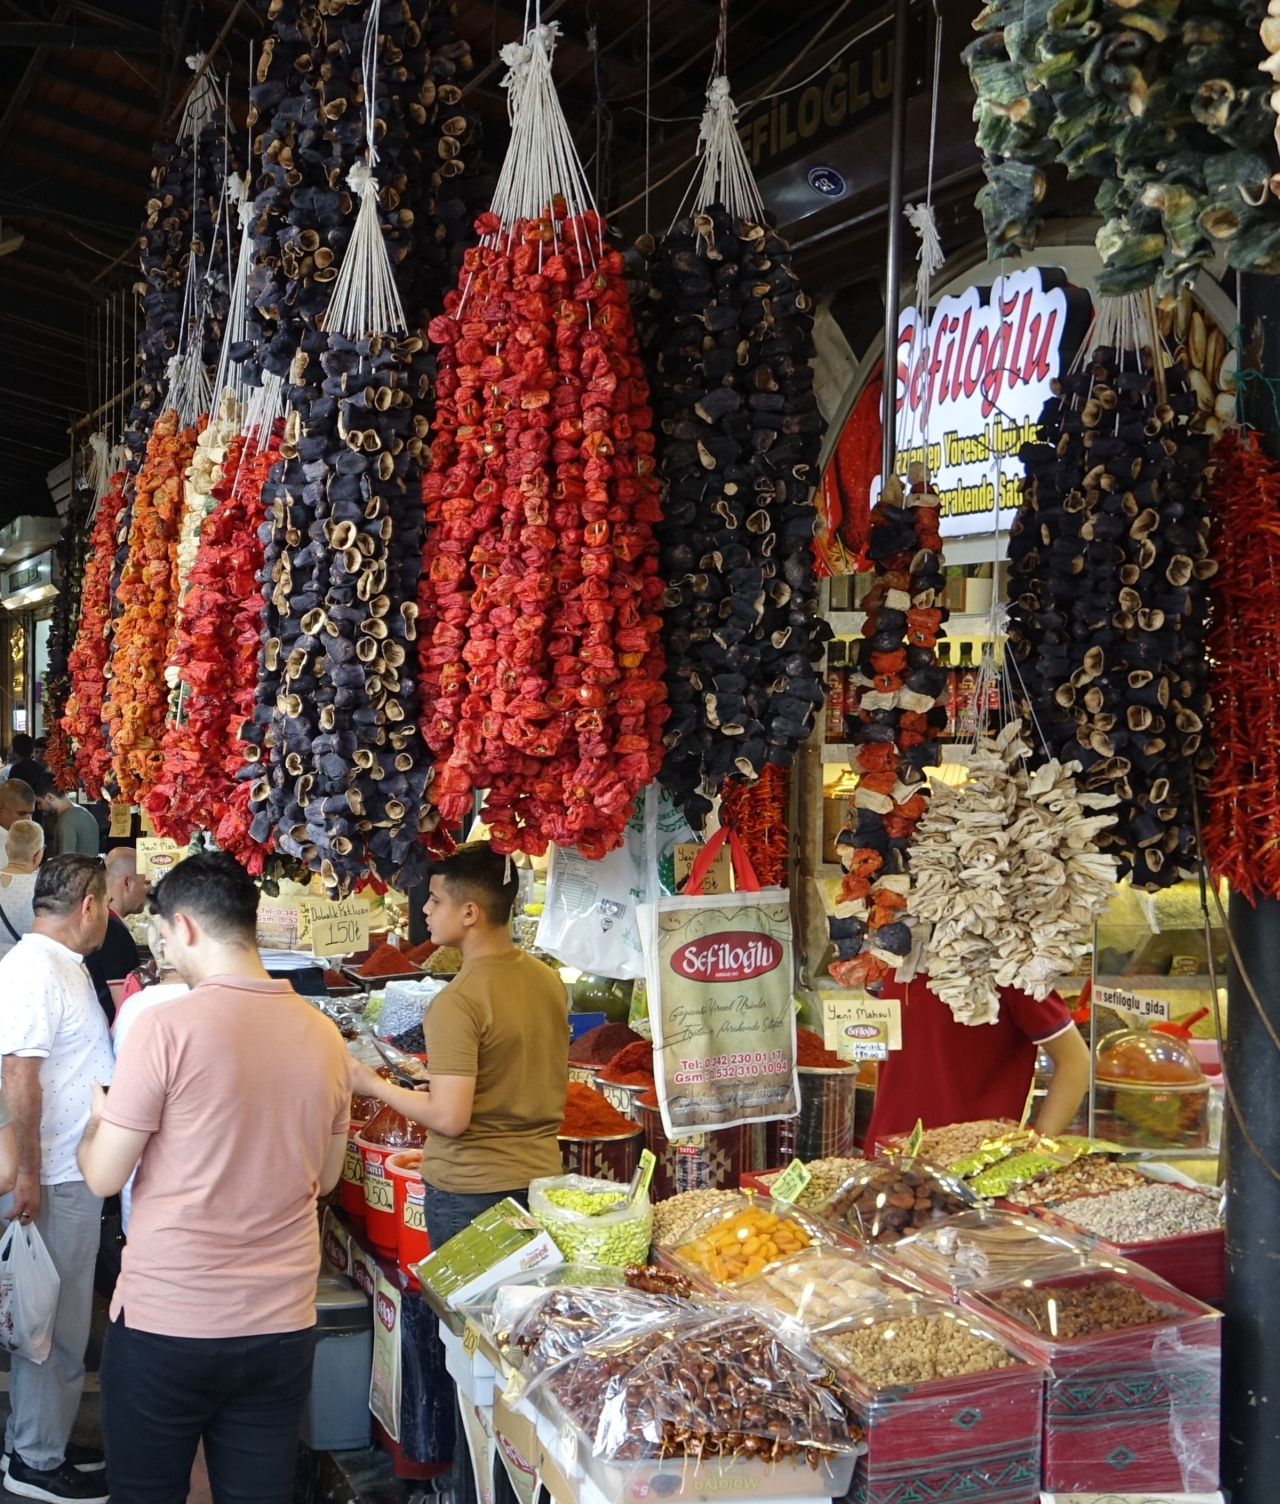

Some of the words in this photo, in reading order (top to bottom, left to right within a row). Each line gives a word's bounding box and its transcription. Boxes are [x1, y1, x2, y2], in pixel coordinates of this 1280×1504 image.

[739, 41, 896, 166] EFİLOĞLU
[943, 430, 990, 468] Yöresel
[933, 476, 995, 518] erakende
[140, 841, 157, 851] Yeni
[682, 940, 774, 977] Sefiloğlu
[828, 1004, 852, 1020] Yeni
[1103, 991, 1165, 1016] sefiloglu_gida
[681, 1061, 703, 1071] Tel:
[705, 1056, 728, 1069] 0.342
[731, 1053, 752, 1063] 230
[755, 1052, 768, 1062] 01
[771, 1050, 782, 1060] 17
[674, 1073, 703, 1083] Gsm
[738, 1064, 759, 1076] 310
[762, 1063, 774, 1073] 10
[776, 1061, 788, 1072] 94
[366, 1164, 382, 1175] TATLI
[639, 1485, 649, 1496] 5
[692, 1478, 759, 1492] Malatya
